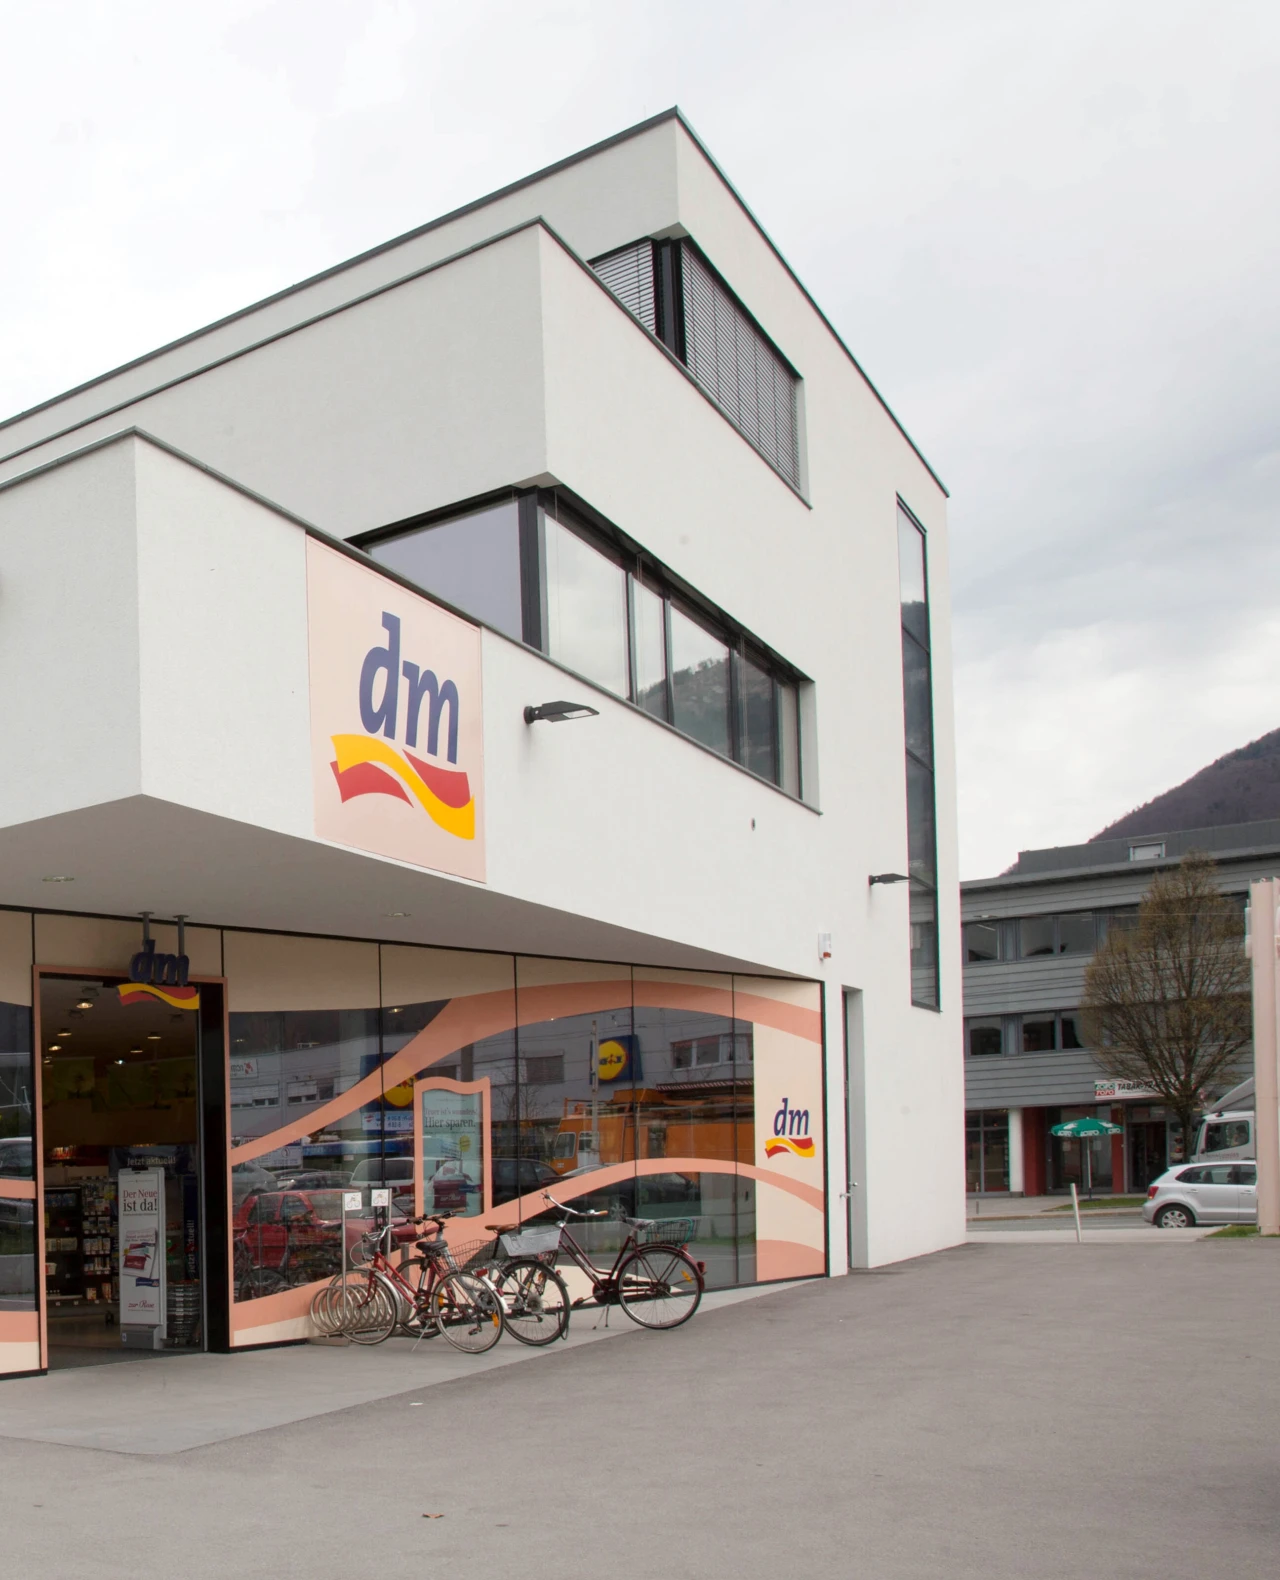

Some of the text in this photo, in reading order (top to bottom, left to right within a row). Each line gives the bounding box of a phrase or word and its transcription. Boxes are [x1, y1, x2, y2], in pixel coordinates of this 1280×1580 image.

[359, 610, 459, 766] dm
[129, 939, 189, 985] dm
[426, 1116, 443, 1128] Hier
[446, 1119, 476, 1130] sparen.
[773, 1097, 809, 1136] dm
[123, 1189, 158, 1199] Der Neue
[123, 1198, 158, 1212] ist da!
